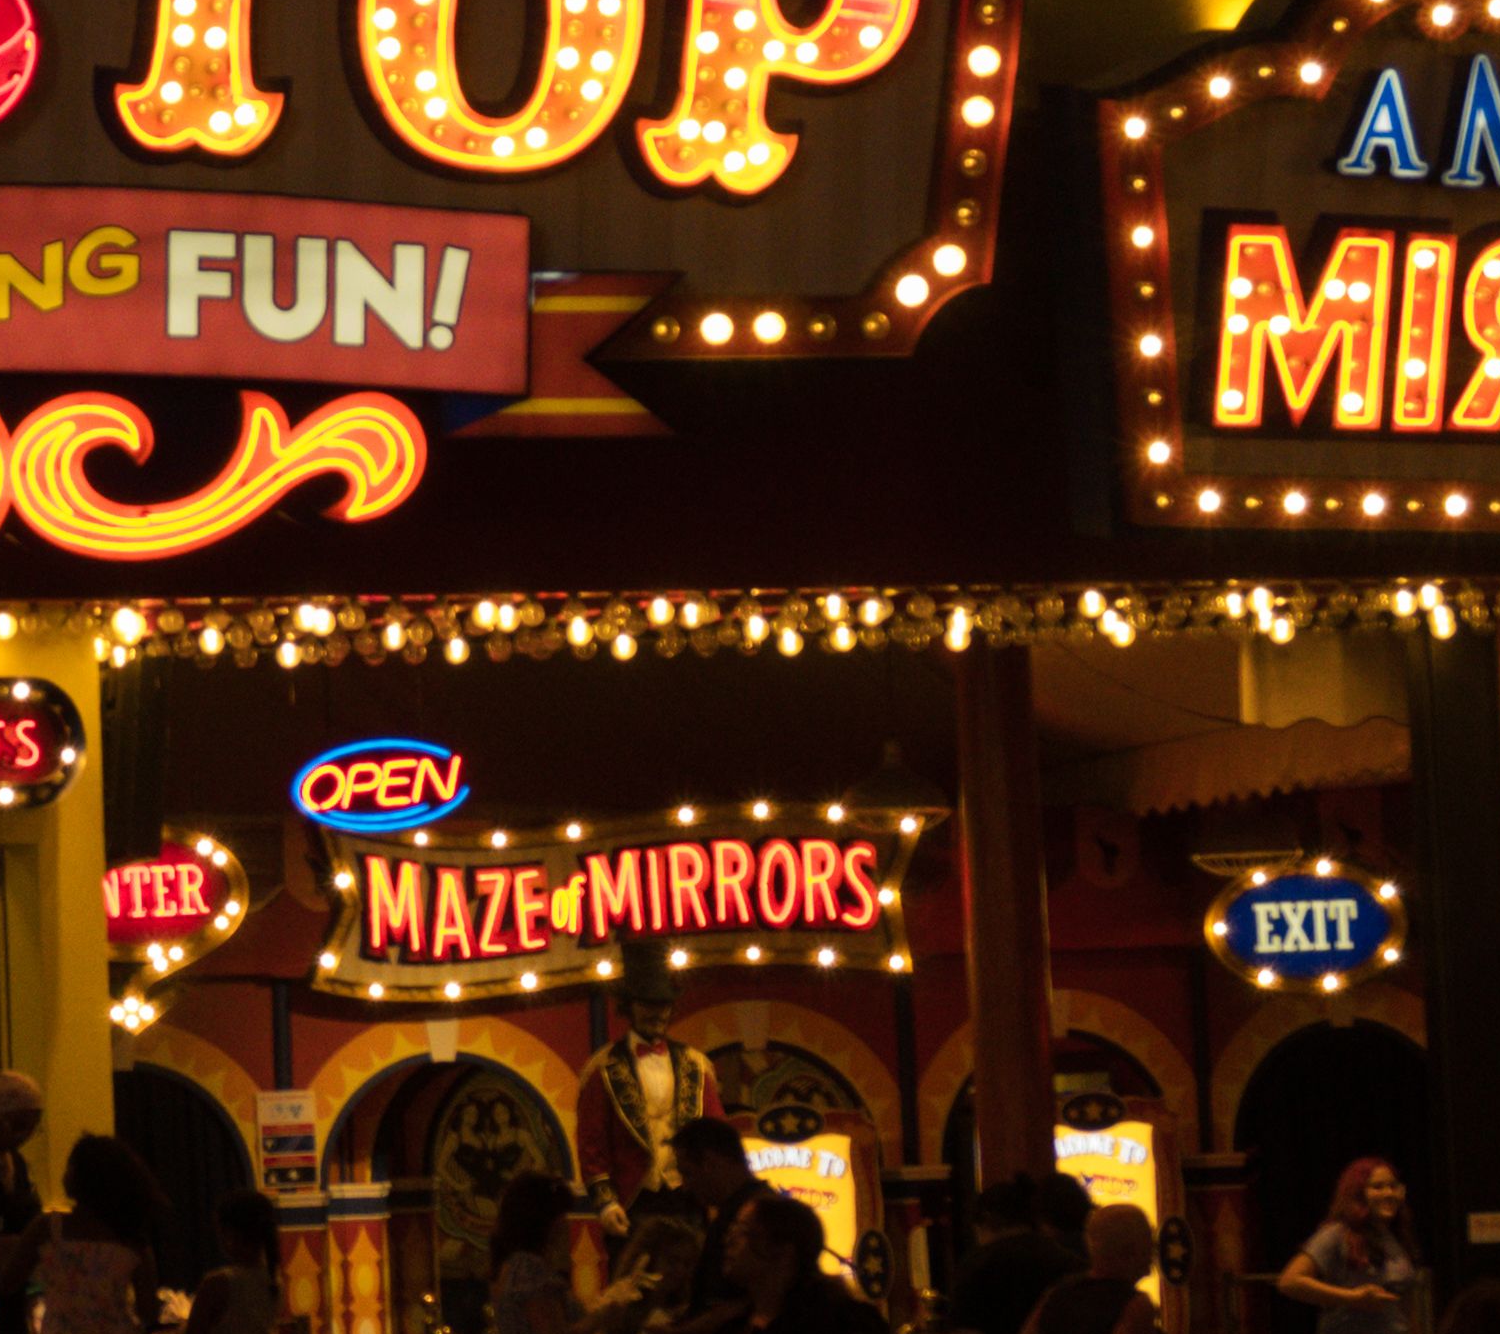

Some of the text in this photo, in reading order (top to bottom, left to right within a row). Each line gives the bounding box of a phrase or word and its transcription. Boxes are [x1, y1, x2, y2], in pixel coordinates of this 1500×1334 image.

[1338, 68, 1428, 178] A
[164, 227, 472, 354] FUN!
[301, 754, 462, 811] OPEN
[364, 839, 879, 960] MAZE of MIRRORS
[1251, 898, 1358, 953] EXIT
